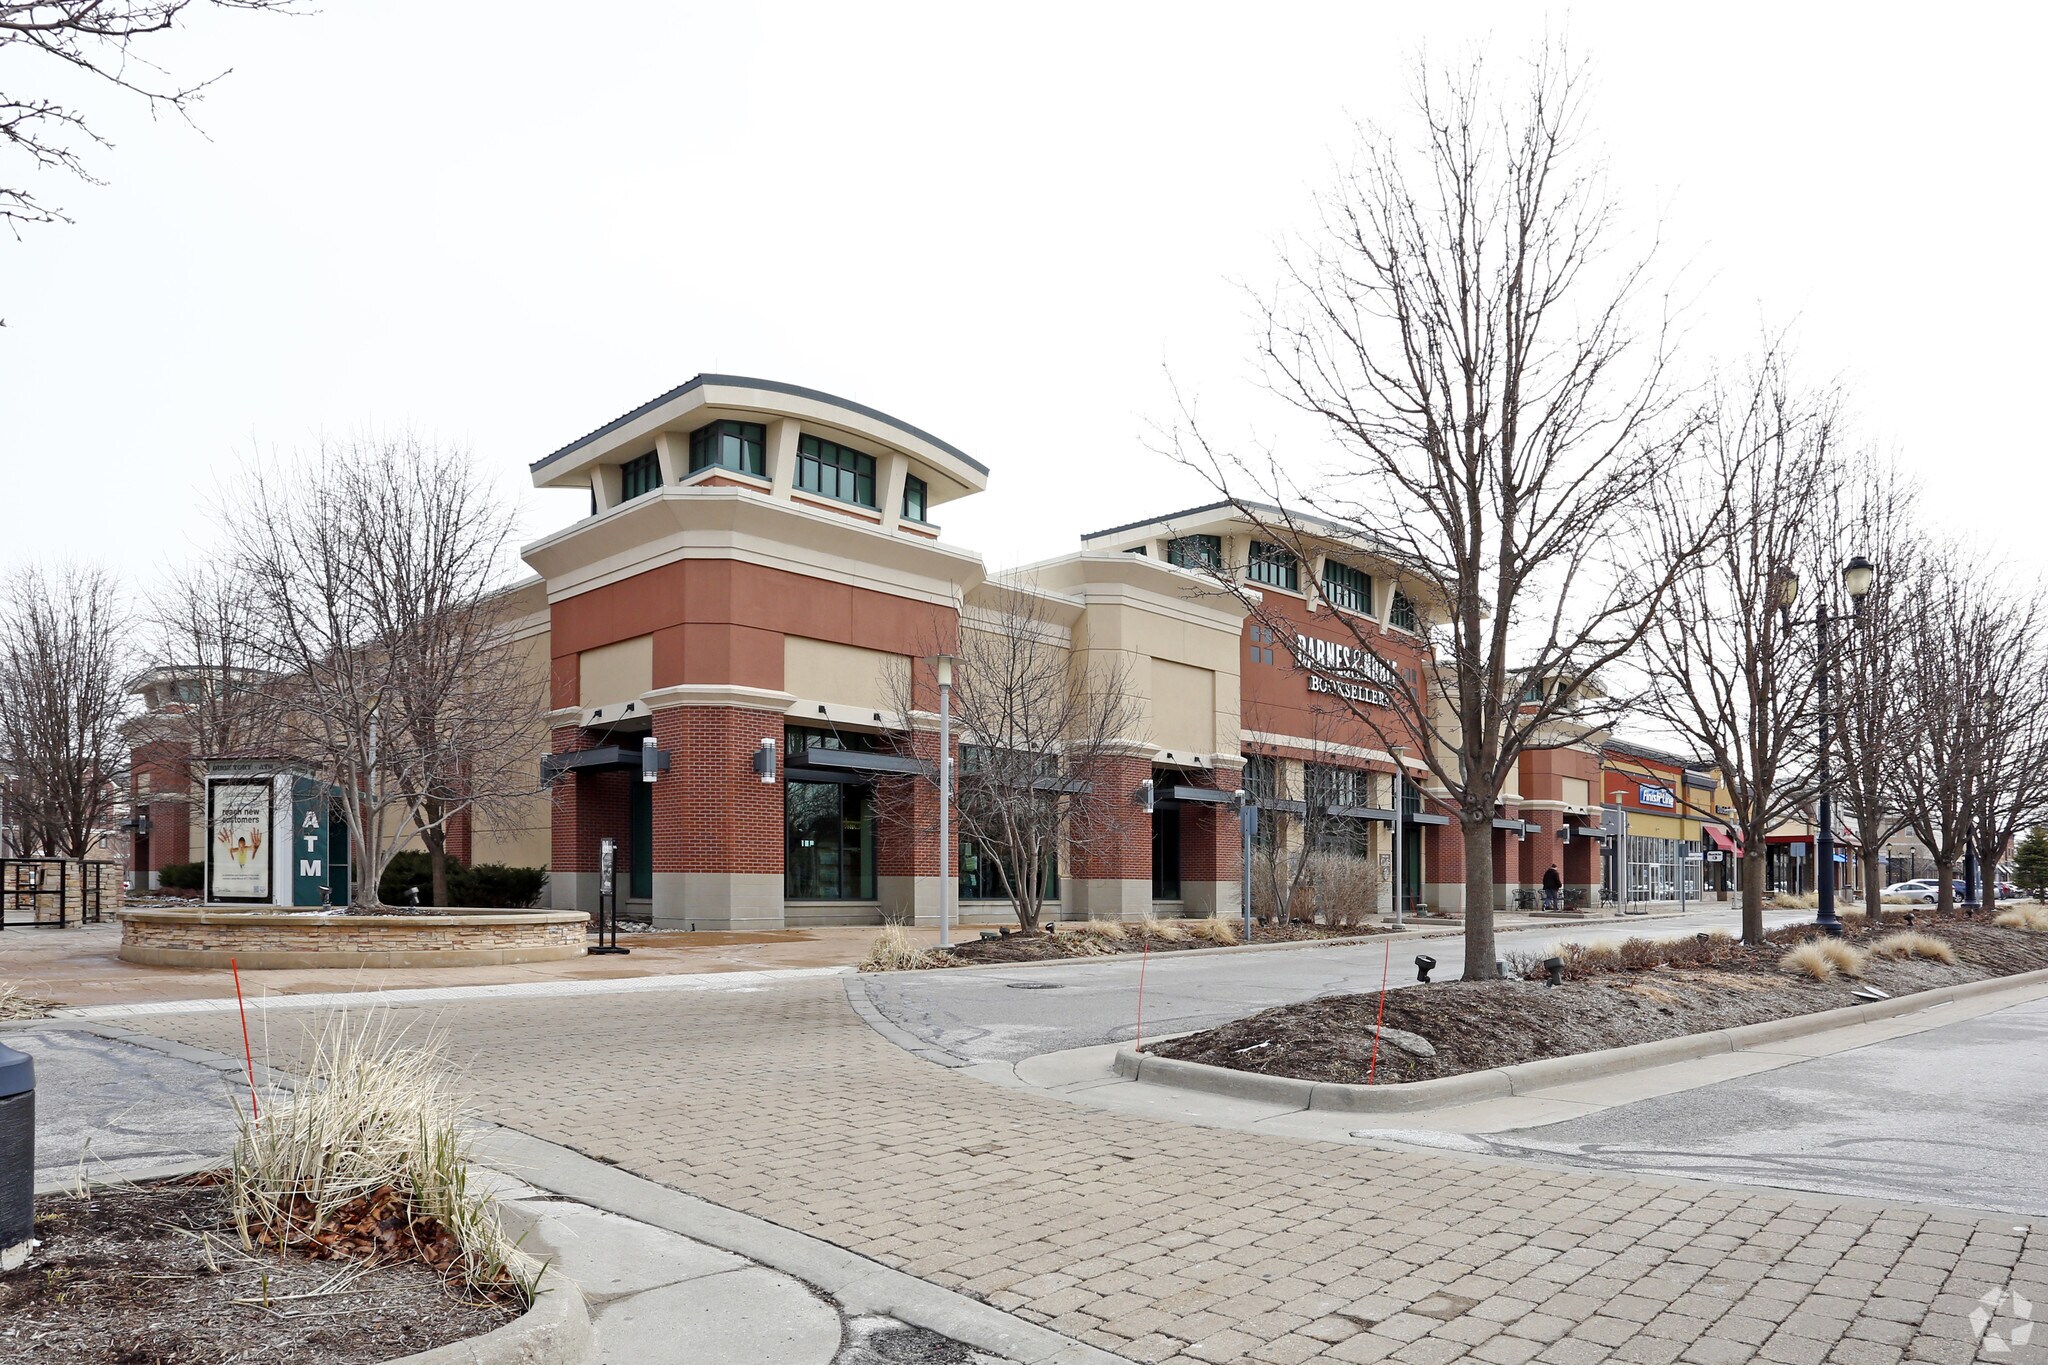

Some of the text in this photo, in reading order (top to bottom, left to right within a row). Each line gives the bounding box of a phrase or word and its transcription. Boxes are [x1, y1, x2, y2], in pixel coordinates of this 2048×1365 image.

[1297, 634, 1351, 678] BARNES
[1352, 649, 1364, 681] &
[300, 811, 322, 877] ATM
